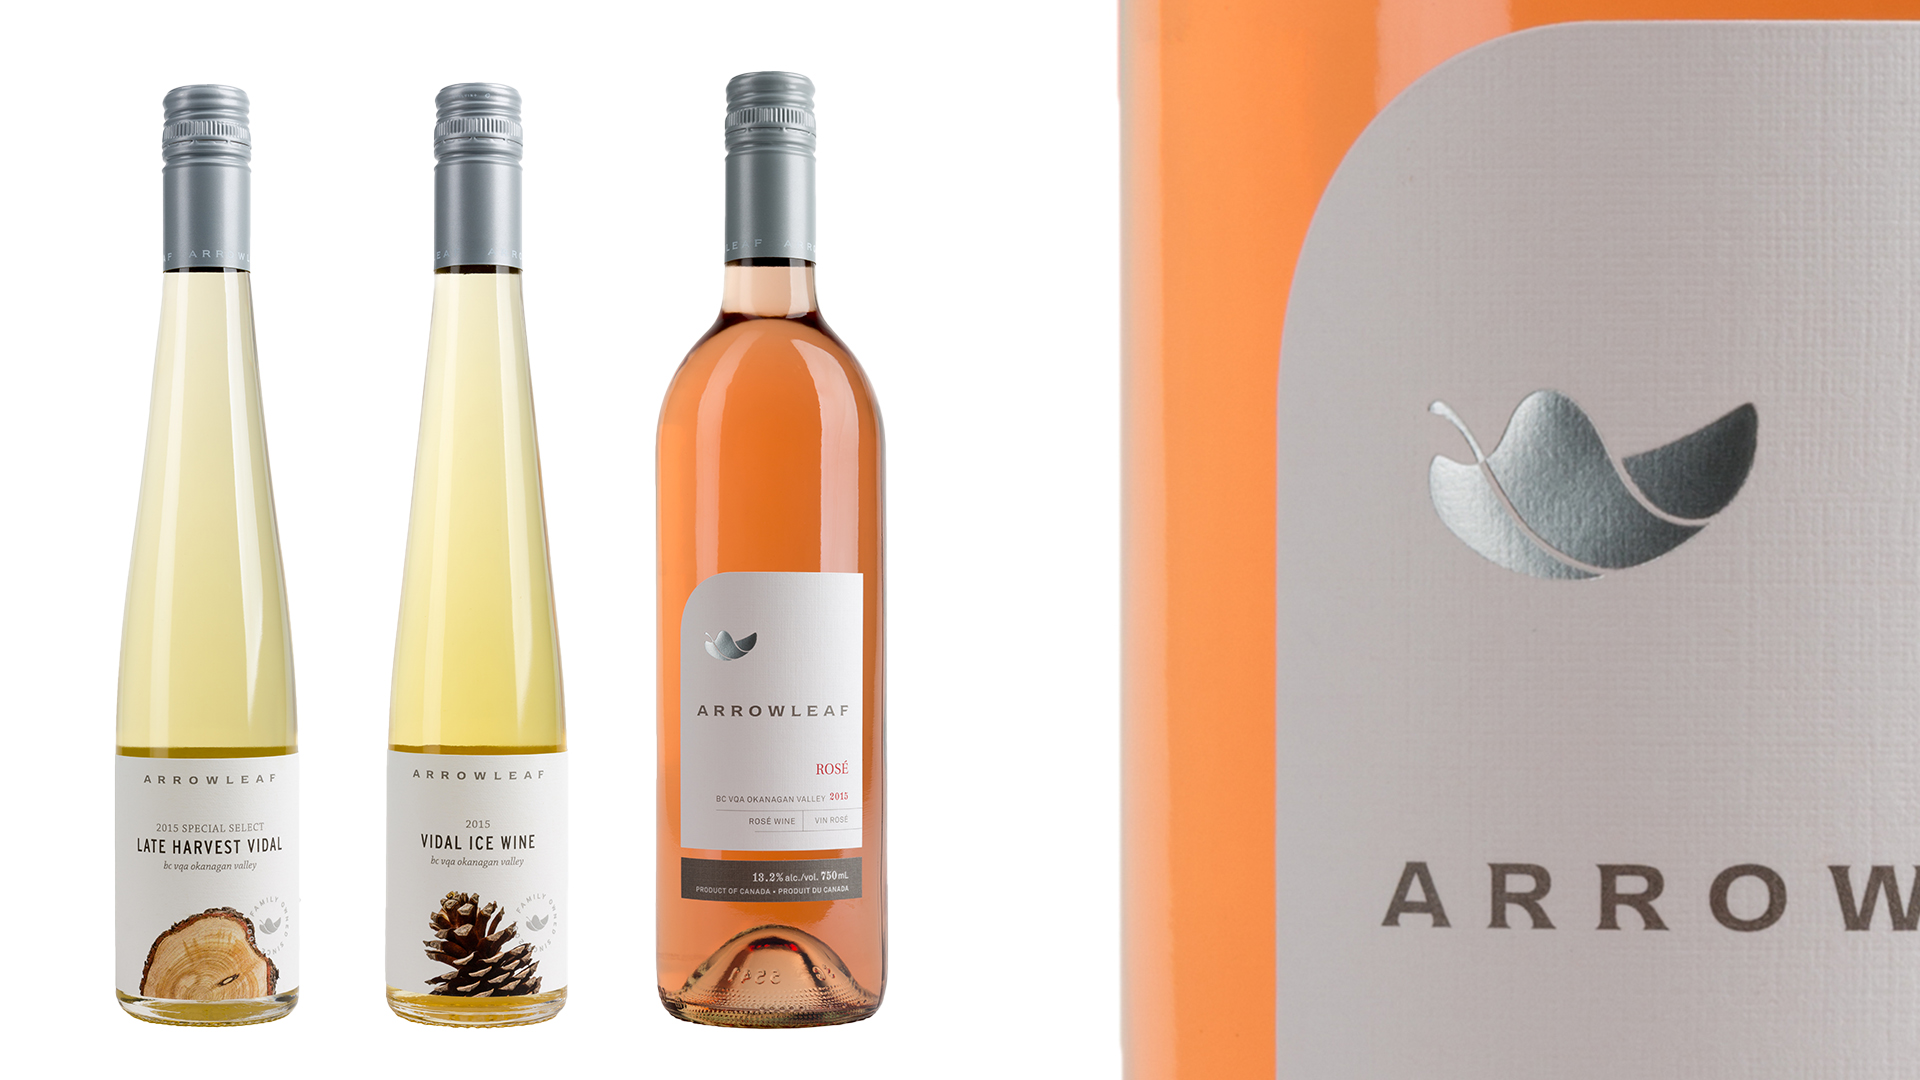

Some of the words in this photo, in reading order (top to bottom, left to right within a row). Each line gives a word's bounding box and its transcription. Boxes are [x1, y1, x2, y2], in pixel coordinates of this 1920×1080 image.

[696, 704, 849, 717] ARROWLEAF
[816, 760, 849, 776] ROSÉ
[144, 774, 276, 784] ARROWLEAF
[412, 769, 544, 780] ARROWLEAF
[728, 795, 745, 803] VQA
[746, 795, 794, 803] OKANAGAN
[795, 794, 826, 803] VALLEY
[829, 792, 849, 801] 2015
[465, 820, 491, 829] 2015
[748, 816, 771, 825] ROSÉ
[830, 814, 849, 824] ROSÉ
[156, 823, 179, 832] 2015
[182, 824, 226, 833] SPECIAL
[228, 822, 265, 832] SELECT
[137, 838, 166, 854] LATE
[172, 840, 240, 854] HARVEST
[247, 836, 282, 853] VIDAL
[420, 834, 462, 850] VIDAL
[469, 836, 494, 850] ICE
[500, 834, 535, 850] WINE
[163, 861, 172, 870] bc
[174, 863, 189, 872] vqa
[190, 862, 232, 873] okanagan
[234, 860, 257, 871] valley
[430, 856, 440, 865] bc
[440, 858, 456, 867] vqa
[457, 857, 499, 868] okanagan
[500, 856, 524, 867] valley
[695, 886, 726, 894] PRODUCT
[823, 885, 849, 893] CANADA
[1381, 861, 1920, 932] ARROW
[250, 896, 278, 917] FAMILY
[516, 893, 546, 914] FAMILY
